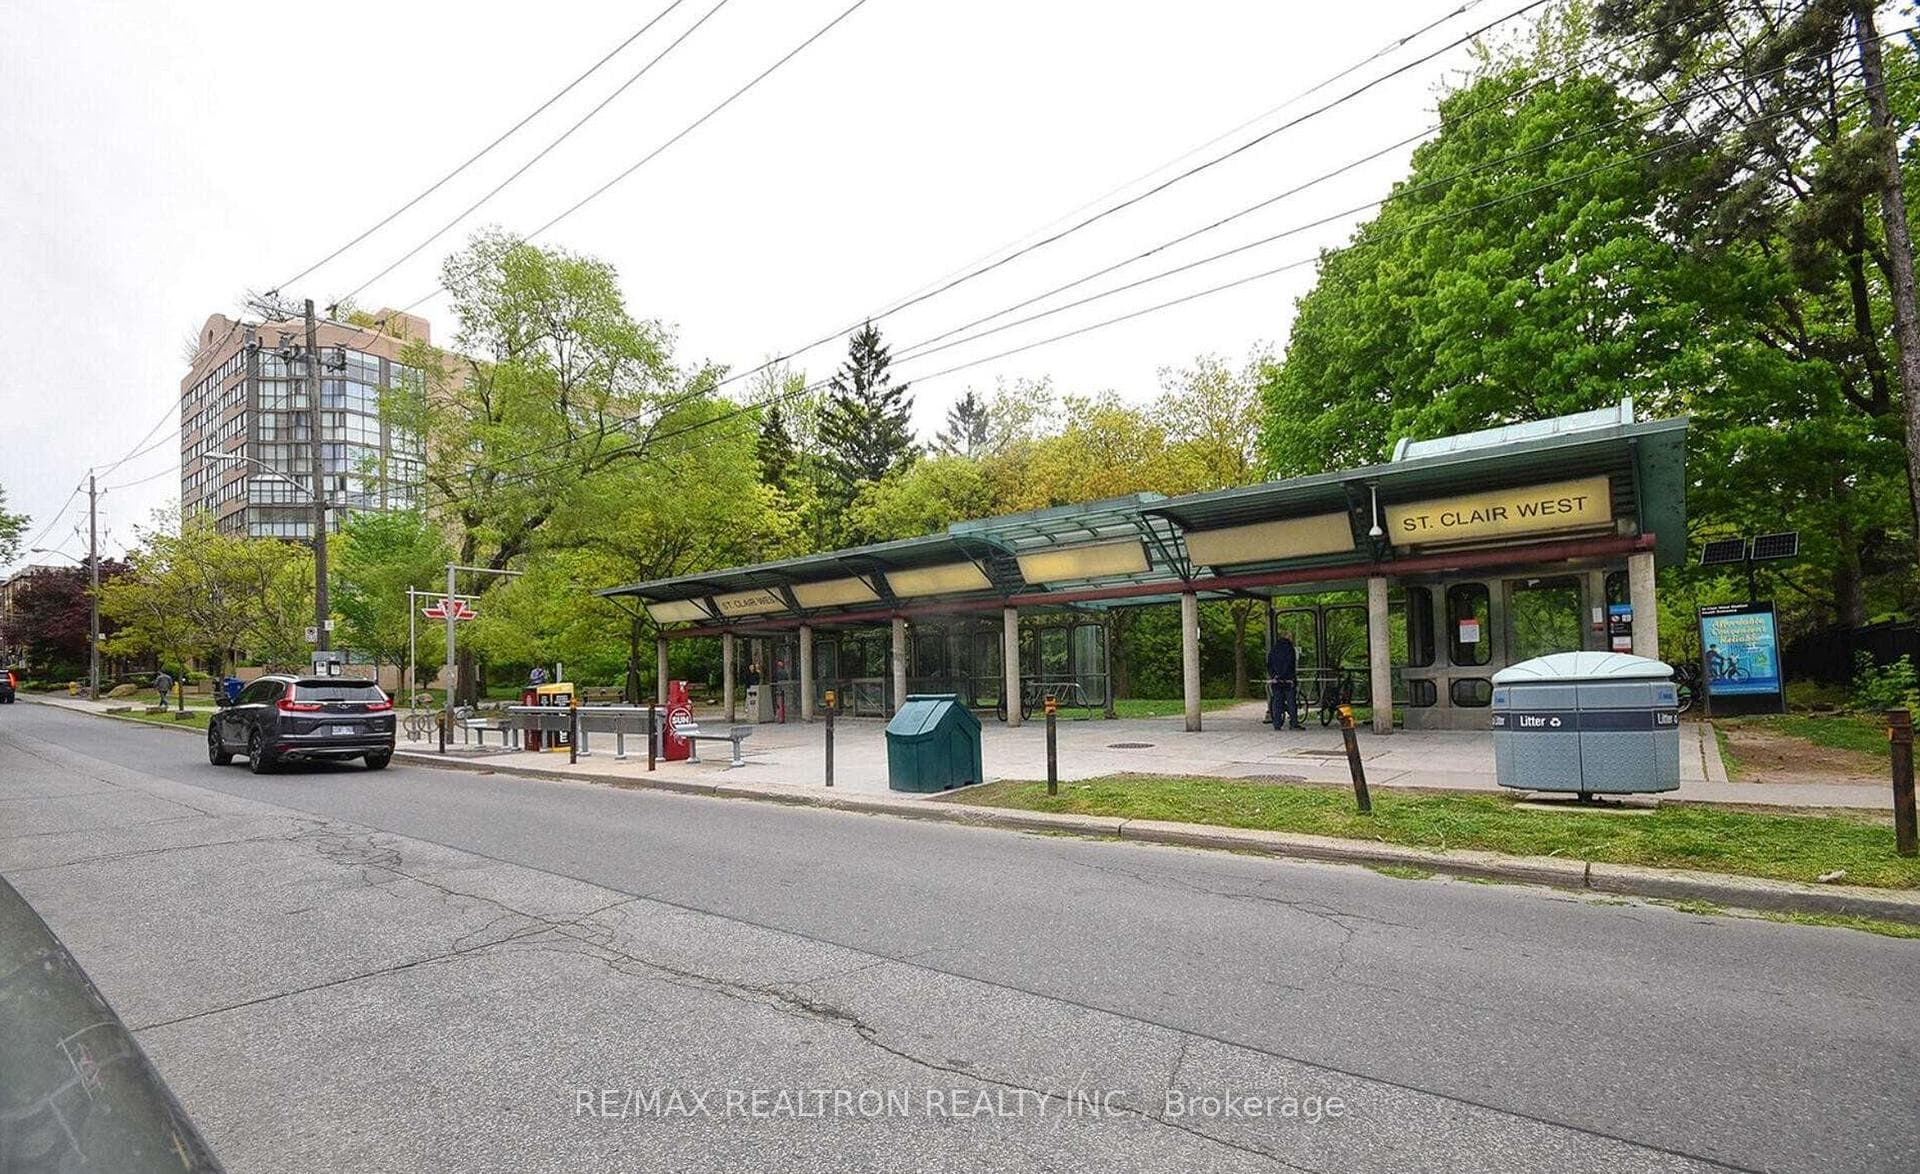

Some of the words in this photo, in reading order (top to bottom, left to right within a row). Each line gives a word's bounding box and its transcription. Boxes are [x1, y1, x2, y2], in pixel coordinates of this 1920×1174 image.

[1403, 515, 1433, 532] ST.
[1440, 506, 1509, 527] CLAIR
[1517, 496, 1588, 518] WEST
[757, 595, 776, 606] WES
[672, 716, 689, 724] SUN
[1519, 715, 1546, 727] Litter
